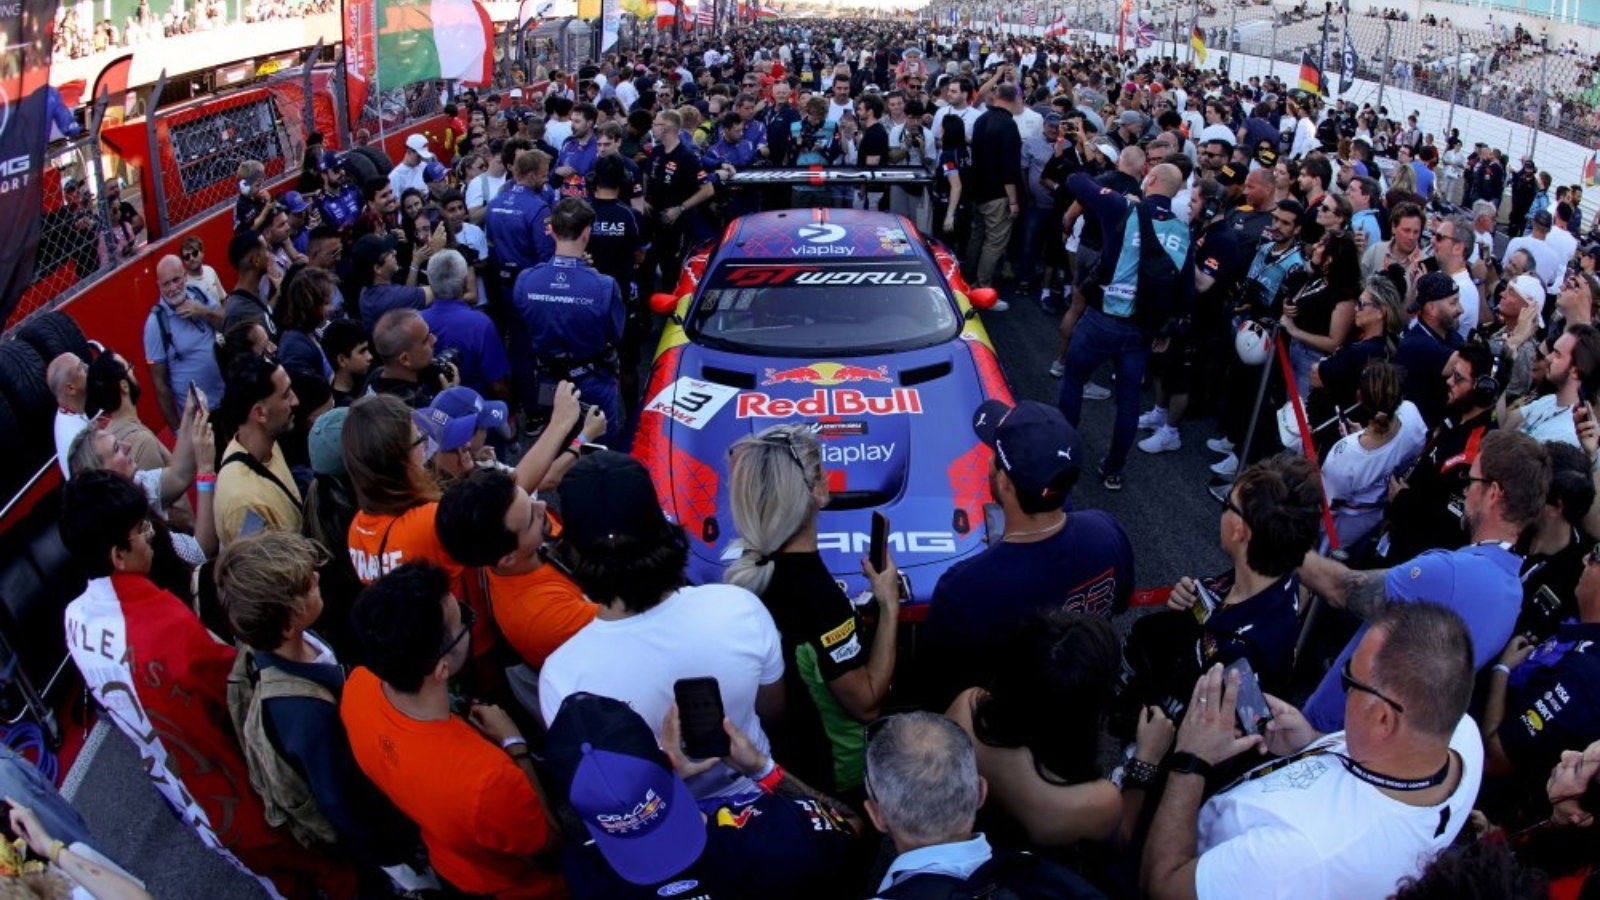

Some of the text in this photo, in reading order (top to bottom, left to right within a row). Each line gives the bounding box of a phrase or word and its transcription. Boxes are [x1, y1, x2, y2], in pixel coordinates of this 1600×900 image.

[791, 245, 856, 256] viaplay
[736, 387, 923, 419] Red Bull
[821, 441, 896, 465] iaplay
